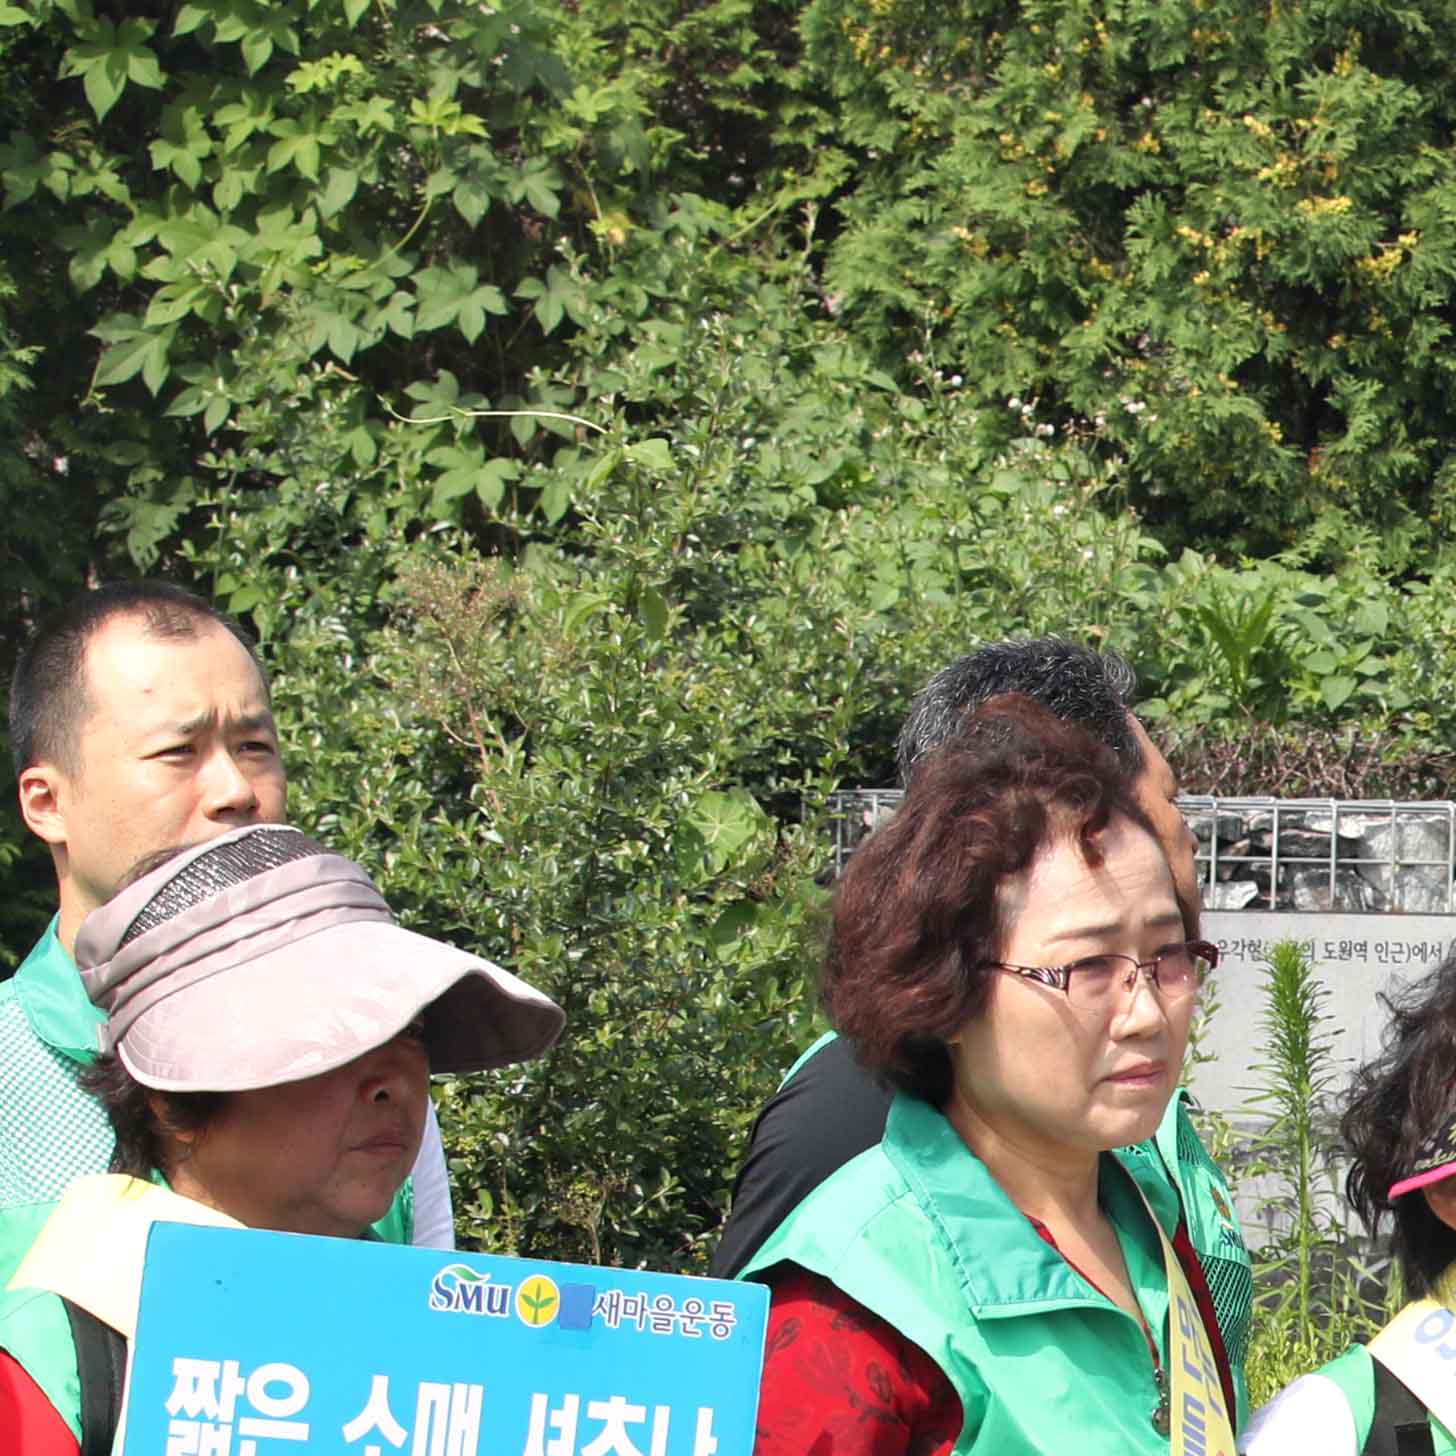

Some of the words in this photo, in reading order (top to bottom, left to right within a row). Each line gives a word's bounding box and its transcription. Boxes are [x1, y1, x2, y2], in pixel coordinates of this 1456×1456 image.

[1322, 939, 1369, 961] 도원역
[1374, 940, 1444, 963] 인근)에서
[430, 1266, 509, 1316] SMU
[592, 1291, 738, 1340] 새마을운동
